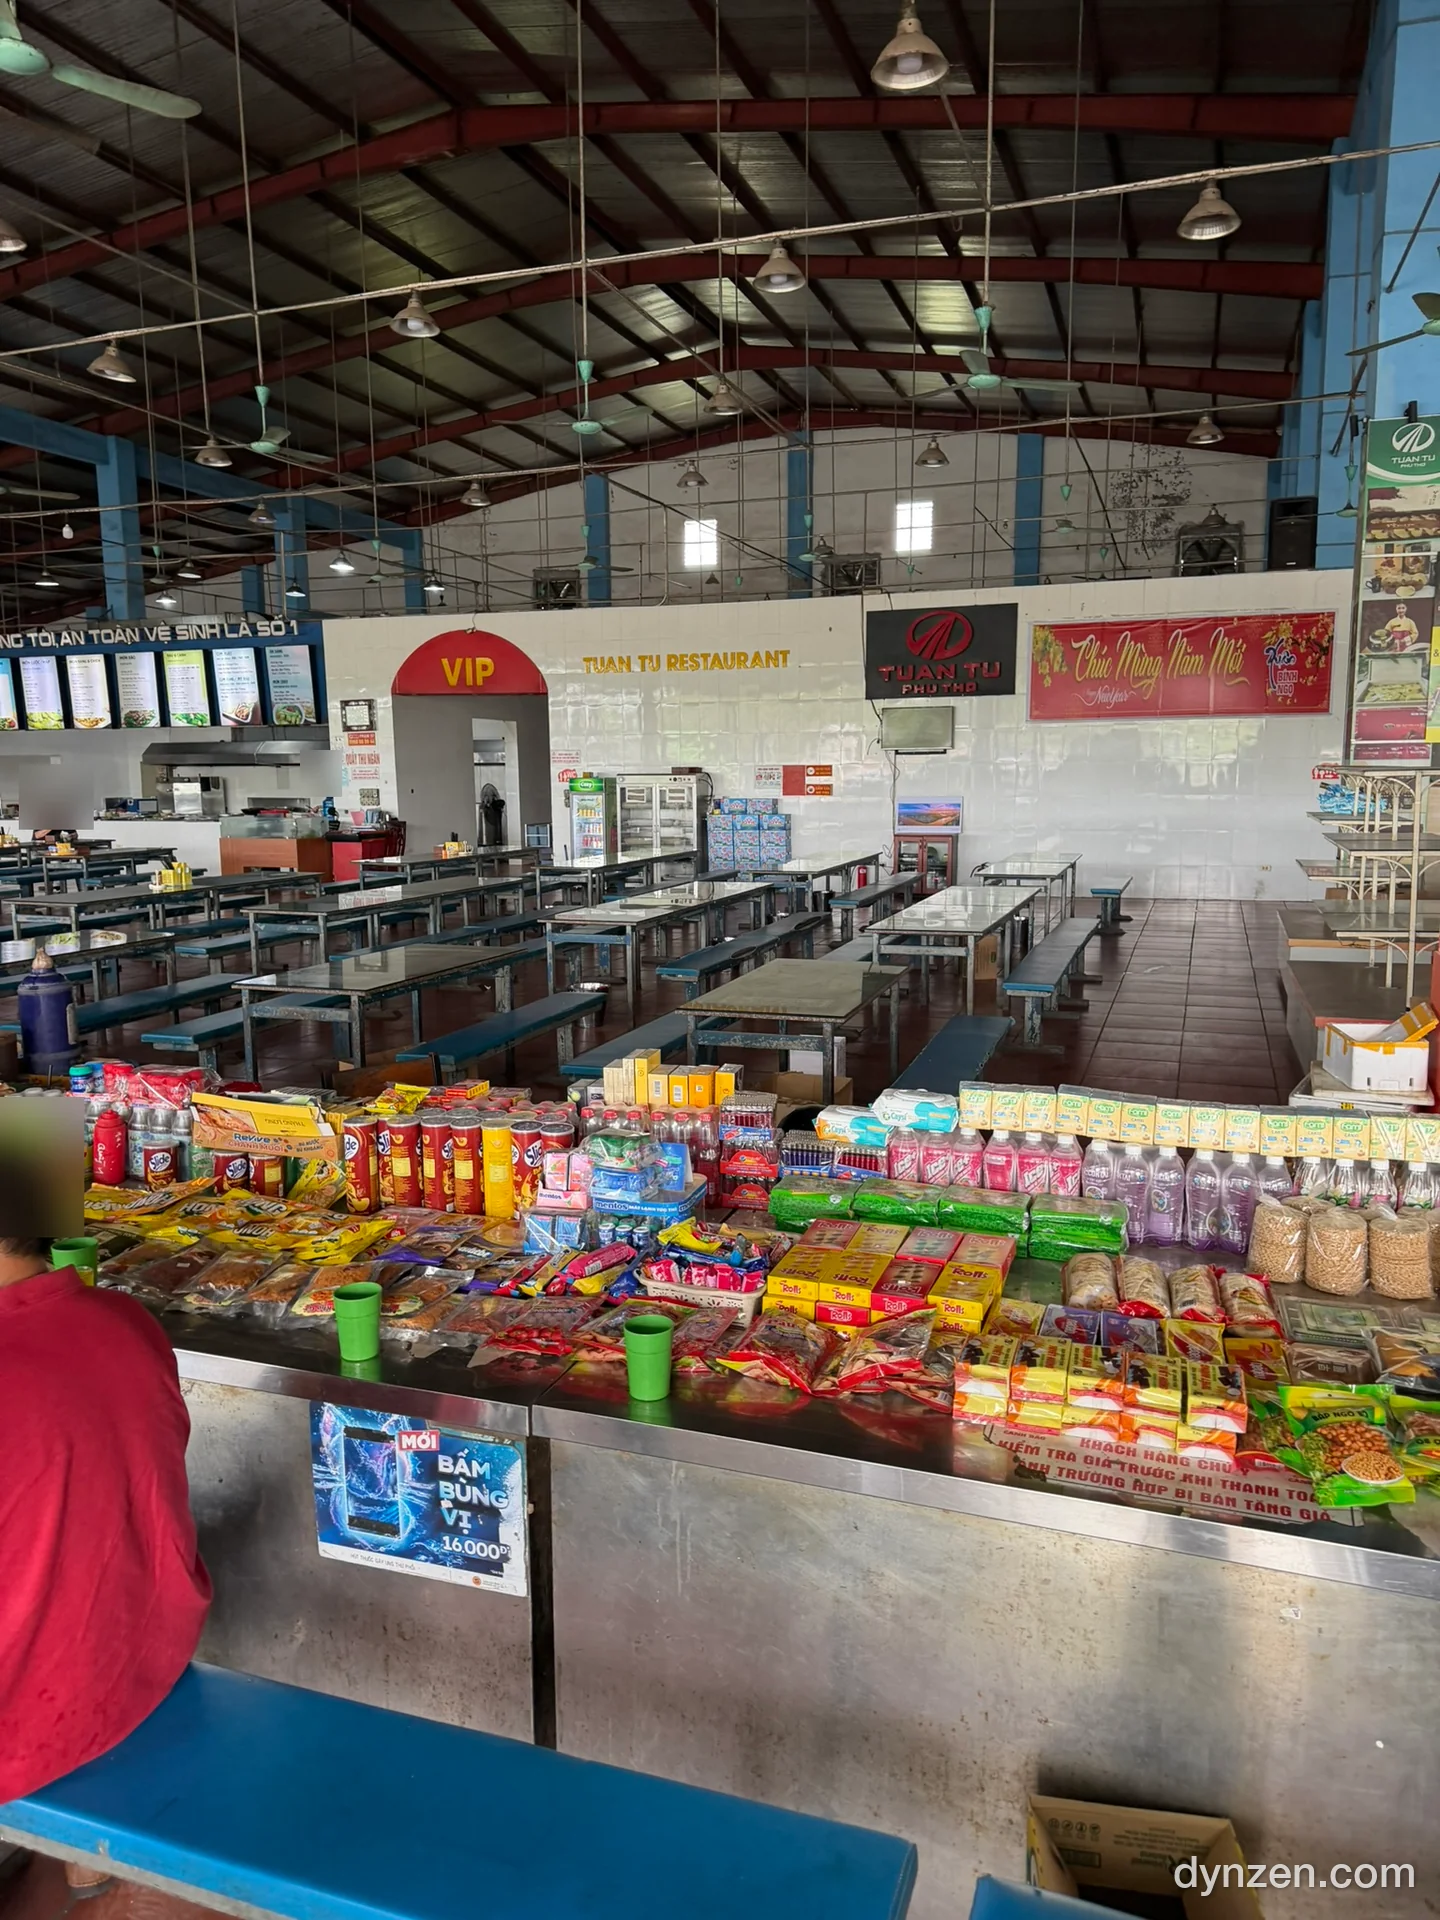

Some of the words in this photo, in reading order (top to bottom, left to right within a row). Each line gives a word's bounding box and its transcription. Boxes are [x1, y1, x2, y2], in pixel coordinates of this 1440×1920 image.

[1391, 455, 1420, 465] TUAN
[1421, 454, 1436, 462] TU
[175, 623, 221, 641] SINH
[224, 616, 253, 639] LÀ
[289, 620, 299, 636] 1
[583, 655, 632, 674] TUAN
[638, 654, 661, 672] TU
[666, 649, 790, 672] RESTAURANT
[1071, 634, 1113, 682] Chúc
[1115, 631, 1164, 700] Mừng
[1166, 628, 1206, 680] Năm
[1209, 626, 1251, 686] Mới
[441, 655, 495, 688] VIP
[878, 662, 957, 682] TUAN
[964, 661, 1001, 679] TU
[902, 684, 938, 695] PHU
[377, 1133, 390, 1152] Sli
[149, 1154, 170, 1169] Slide
[227, 1161, 247, 1176] Slide
[595, 1200, 629, 1211] mentos
[952, 1267, 988, 1279] Rolls
[782, 1284, 801, 1295] Rolls
[835, 1291, 855, 1302] Rolls
[885, 1300, 907, 1311] Rolls
[944, 1304, 965, 1315] Rolls
[831, 1309, 852, 1321] Rolls
[401, 1431, 437, 1449] MỚI
[1079, 1437, 1137, 1457] KHÁCH
[1143, 1449, 1190, 1467] HÀNG
[438, 1448, 491, 1480] BẤM
[998, 1439, 1041, 1456] KIỂM
[1046, 1447, 1077, 1463] TRA
[1083, 1453, 1112, 1469] GIÁ
[1119, 1460, 1176, 1481] TRƯỚC
[1181, 1472, 1213, 1487] KHI
[1220, 1478, 1280, 1498] THANH
[1057, 1466, 1126, 1490] TRƯỜNG
[1132, 1477, 1168, 1496] HỢP
[1174, 1486, 1194, 1502] BỊ
[1200, 1491, 1237, 1508] BÁN
[1243, 1497, 1293, 1518] TĂNG
[440, 1506, 472, 1535] VỊ
